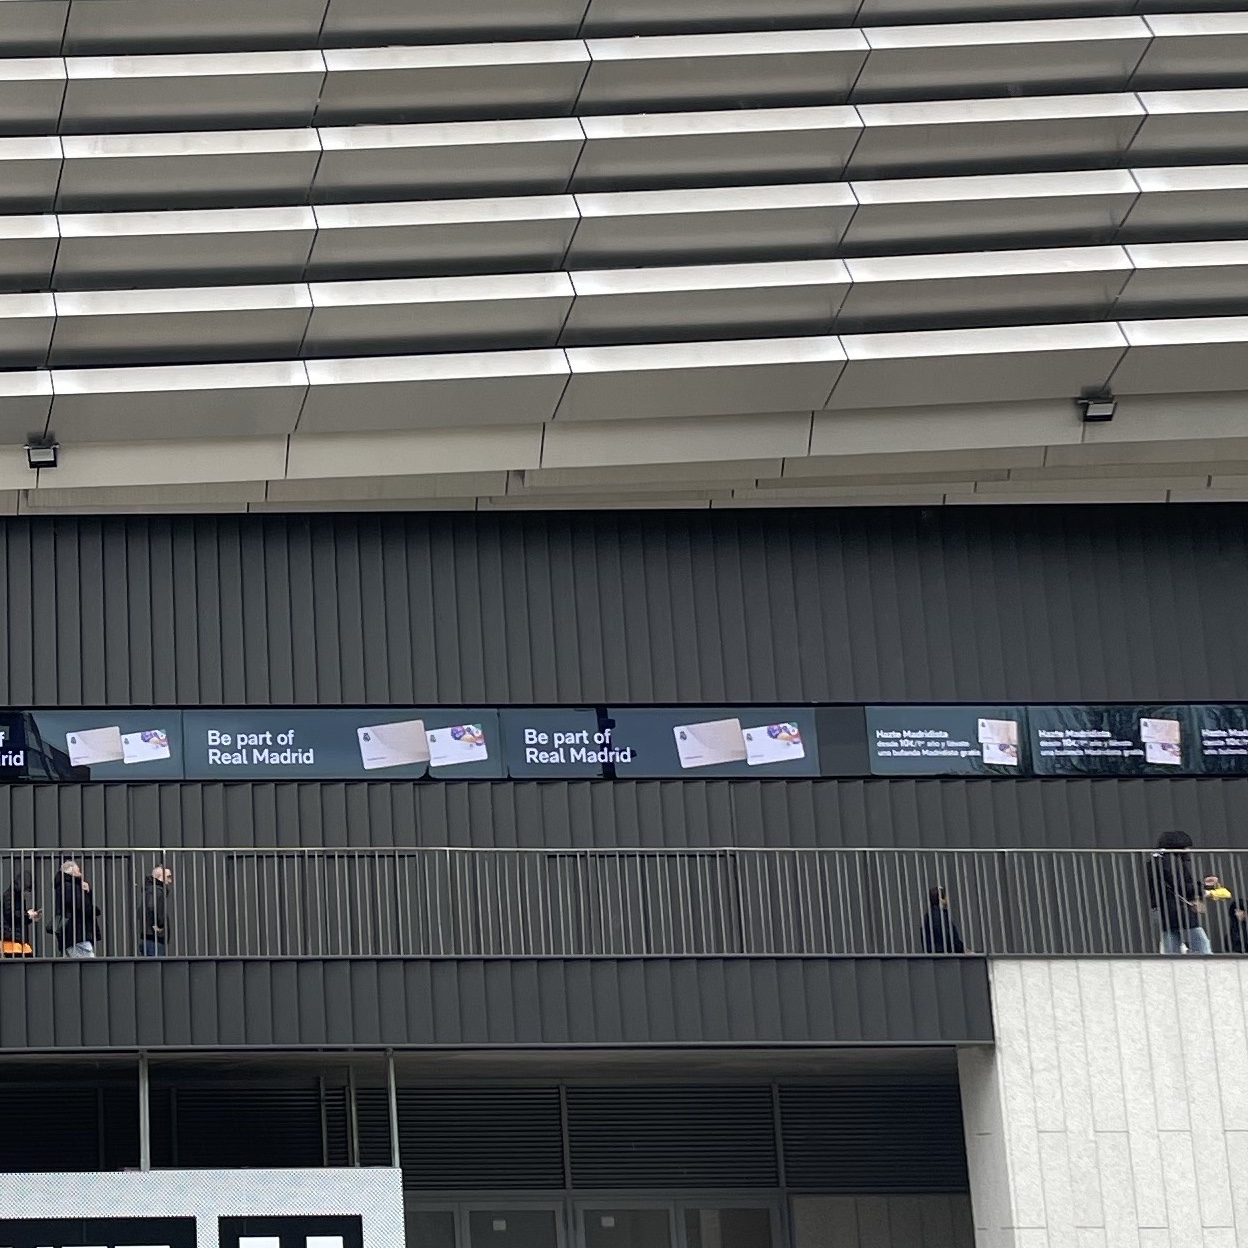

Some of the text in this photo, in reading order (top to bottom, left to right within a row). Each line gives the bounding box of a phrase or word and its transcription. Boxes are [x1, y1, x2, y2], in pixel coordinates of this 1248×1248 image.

[208, 729, 295, 749] Be part of
[524, 728, 611, 748] Be part of
[208, 748, 314, 764] Real Madrid
[526, 746, 631, 763] Real Madrid
